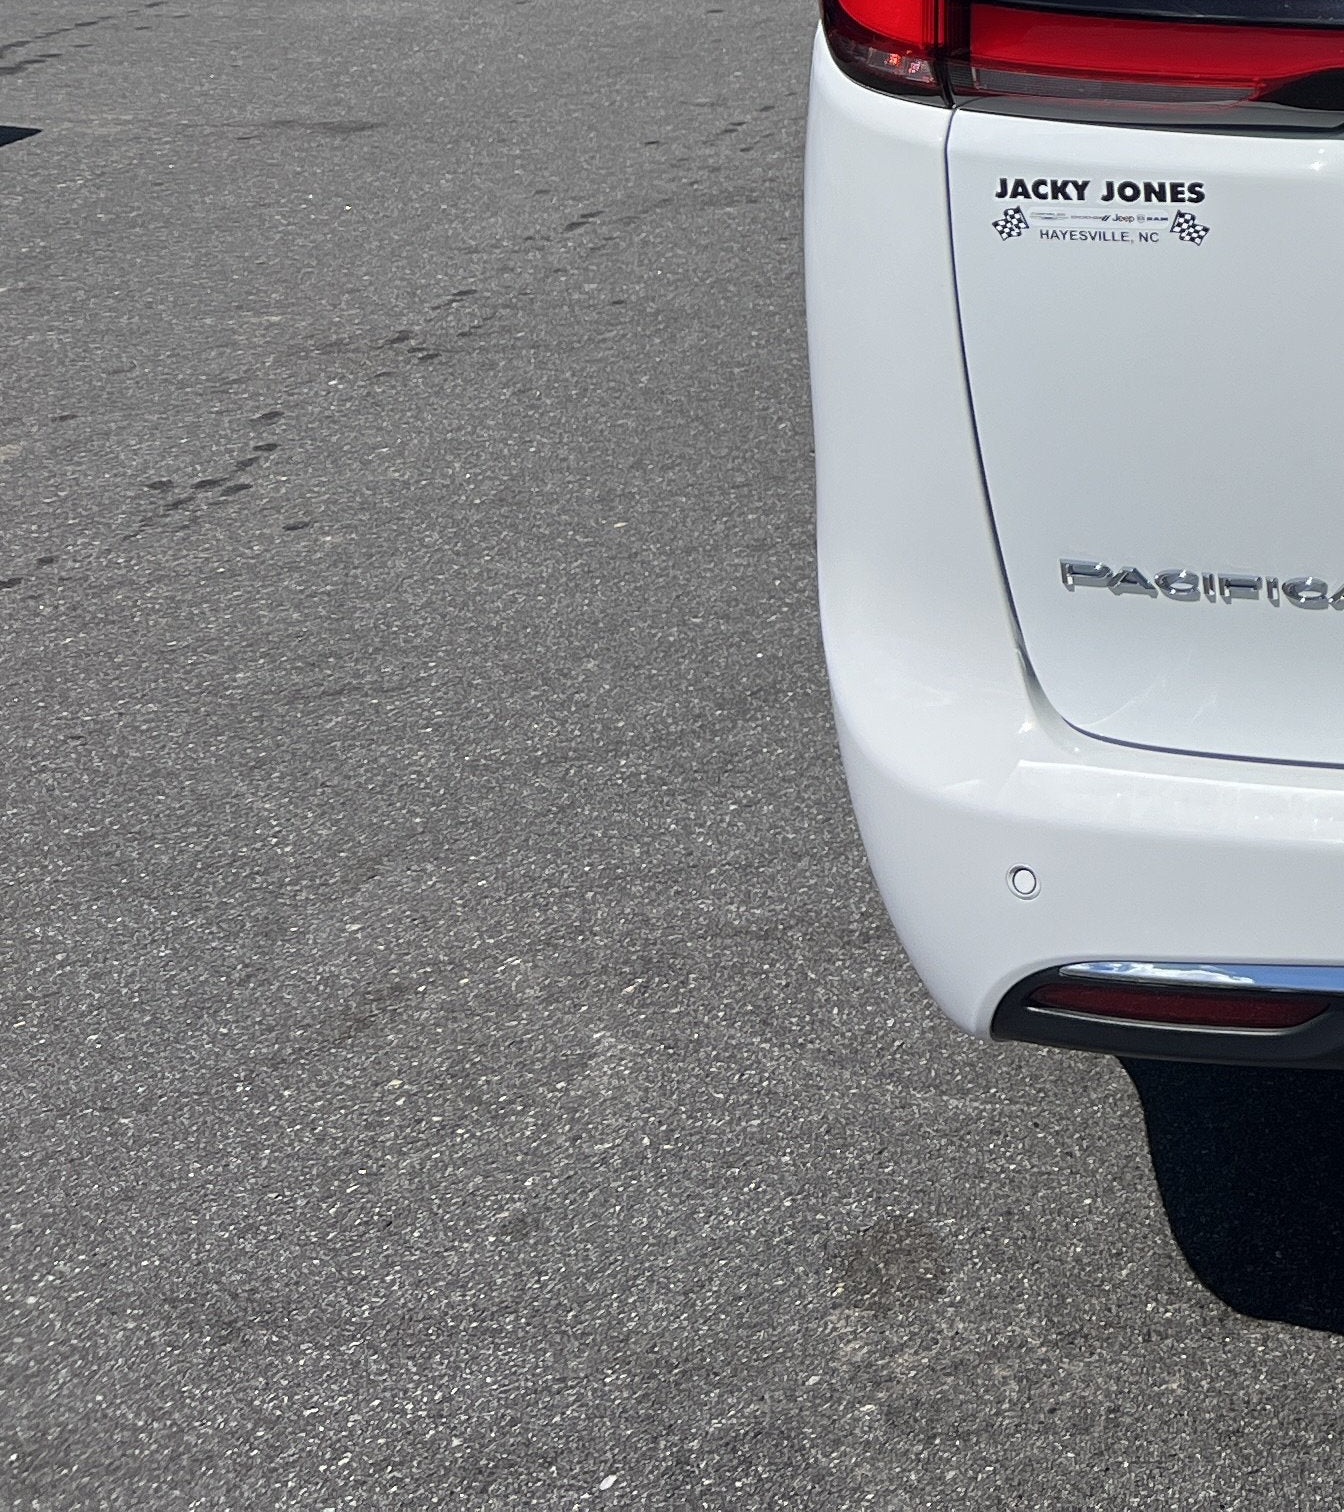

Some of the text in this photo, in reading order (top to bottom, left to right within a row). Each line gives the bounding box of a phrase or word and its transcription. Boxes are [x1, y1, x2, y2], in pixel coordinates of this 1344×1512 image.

[995, 177, 1206, 204] JACKY JONES
[1112, 214, 1135, 224] Jeep
[1040, 229, 1160, 244] HAYESVILLE, NC
